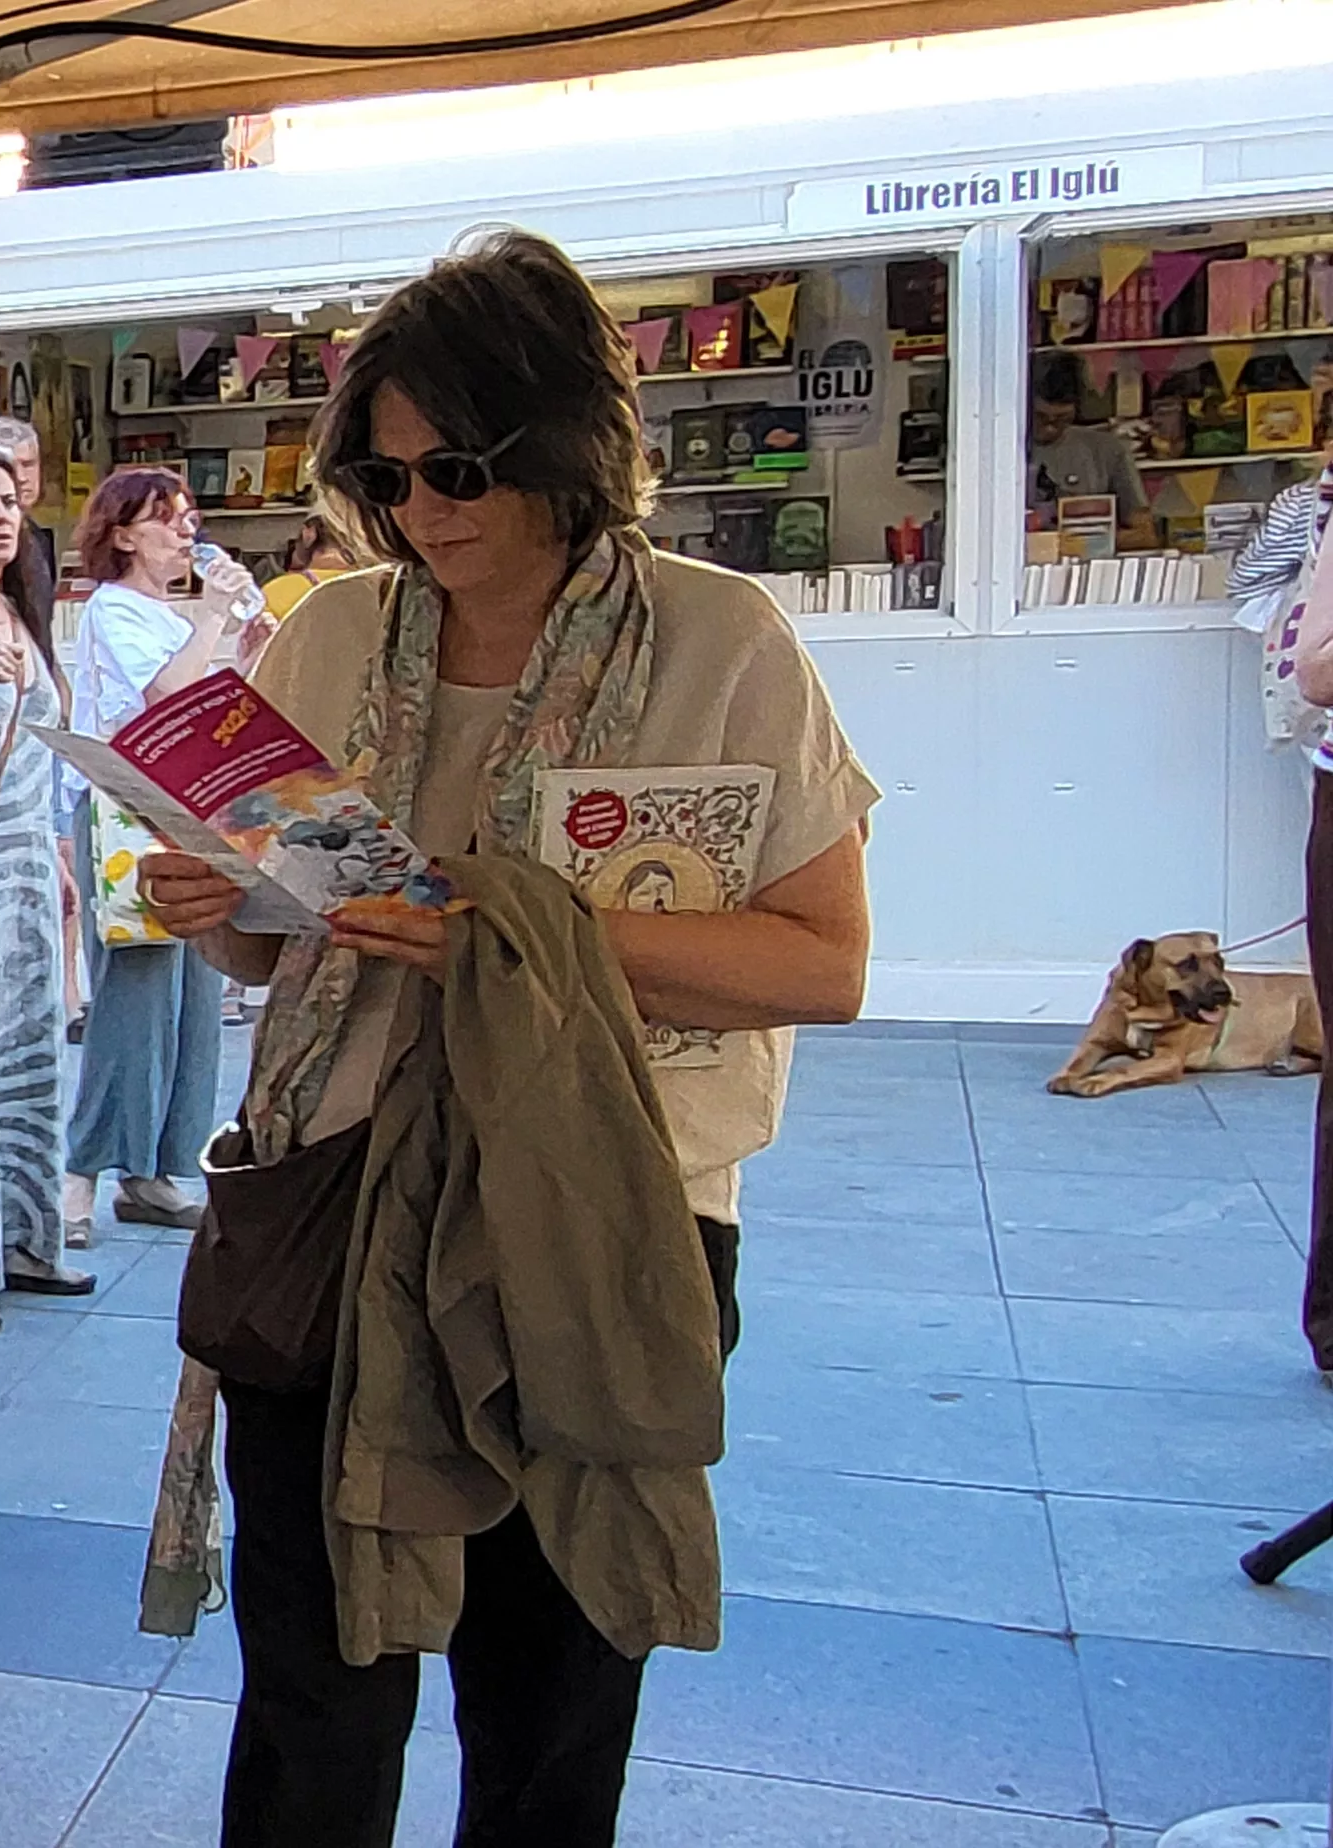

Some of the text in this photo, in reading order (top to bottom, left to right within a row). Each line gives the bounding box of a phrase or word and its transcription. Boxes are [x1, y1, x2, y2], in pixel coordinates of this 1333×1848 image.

[865, 160, 1120, 216] Librería El Iglú
